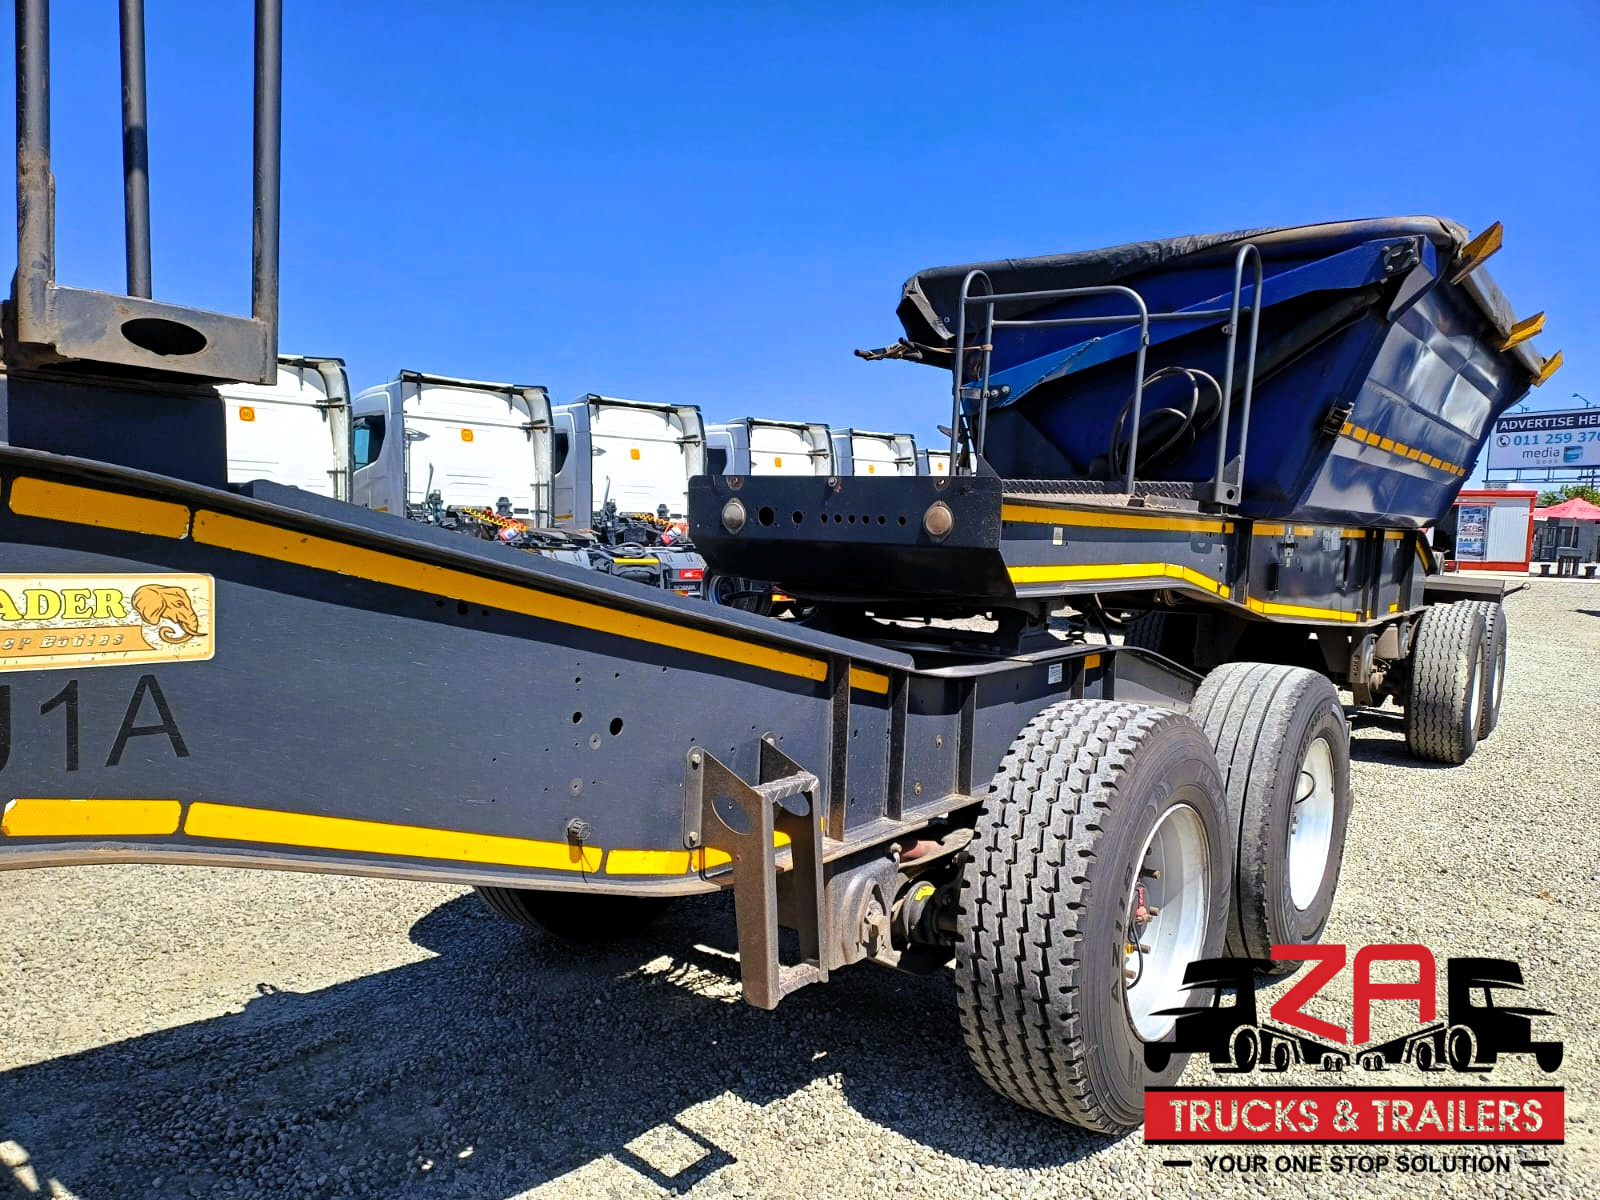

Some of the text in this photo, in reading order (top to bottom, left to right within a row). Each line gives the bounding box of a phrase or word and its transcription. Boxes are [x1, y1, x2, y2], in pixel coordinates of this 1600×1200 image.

[1500, 416, 1574, 430] ADVERTISE
[1513, 434, 1540, 446] 011
[1545, 432, 1572, 444] 259
[1522, 446, 1560, 459] media
